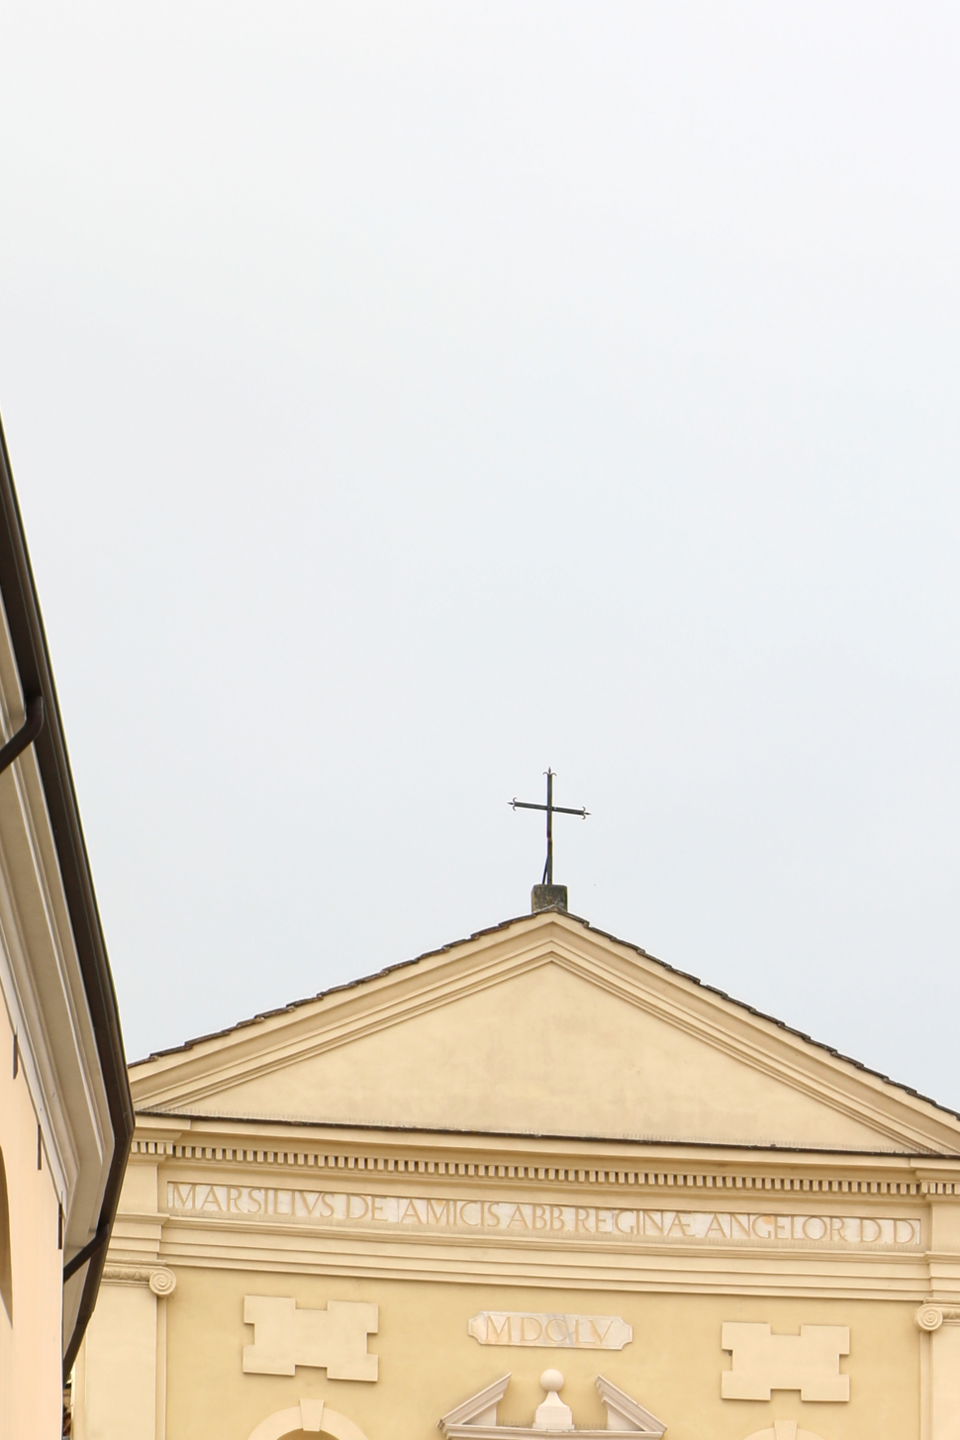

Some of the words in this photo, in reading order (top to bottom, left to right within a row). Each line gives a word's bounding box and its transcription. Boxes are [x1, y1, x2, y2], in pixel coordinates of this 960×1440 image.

[171, 1184, 335, 1218] MARSILIVS
[345, 1193, 389, 1222] DE
[400, 1197, 500, 1228] AMICIS
